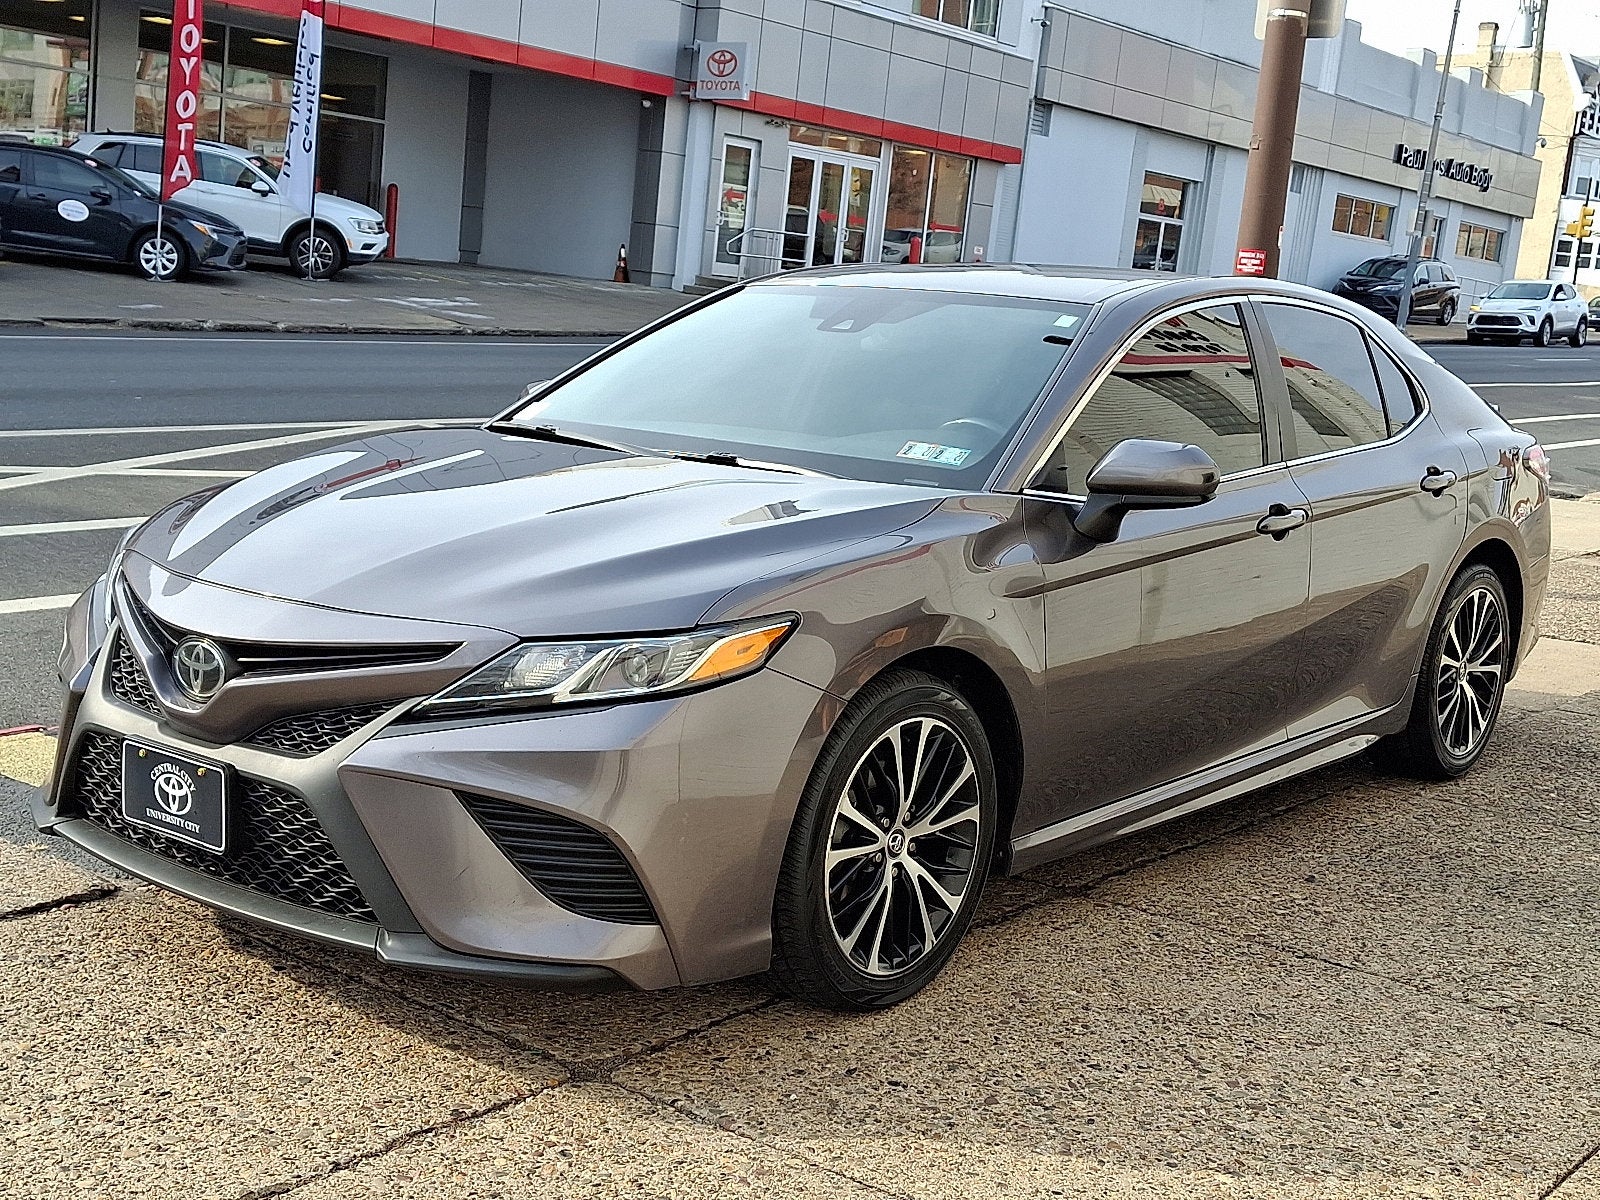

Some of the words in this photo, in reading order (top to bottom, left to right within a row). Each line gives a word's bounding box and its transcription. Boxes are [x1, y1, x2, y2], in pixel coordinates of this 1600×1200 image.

[700, 80, 741, 91] TOYOTA
[1398, 144, 1423, 169] Paul
[1448, 160, 1470, 181] Auto
[150, 762, 181, 780] CENTRAL
[180, 770, 197, 792] CITY
[145, 807, 185, 828] UNIVERSITY
[184, 820, 201, 834] CITY
